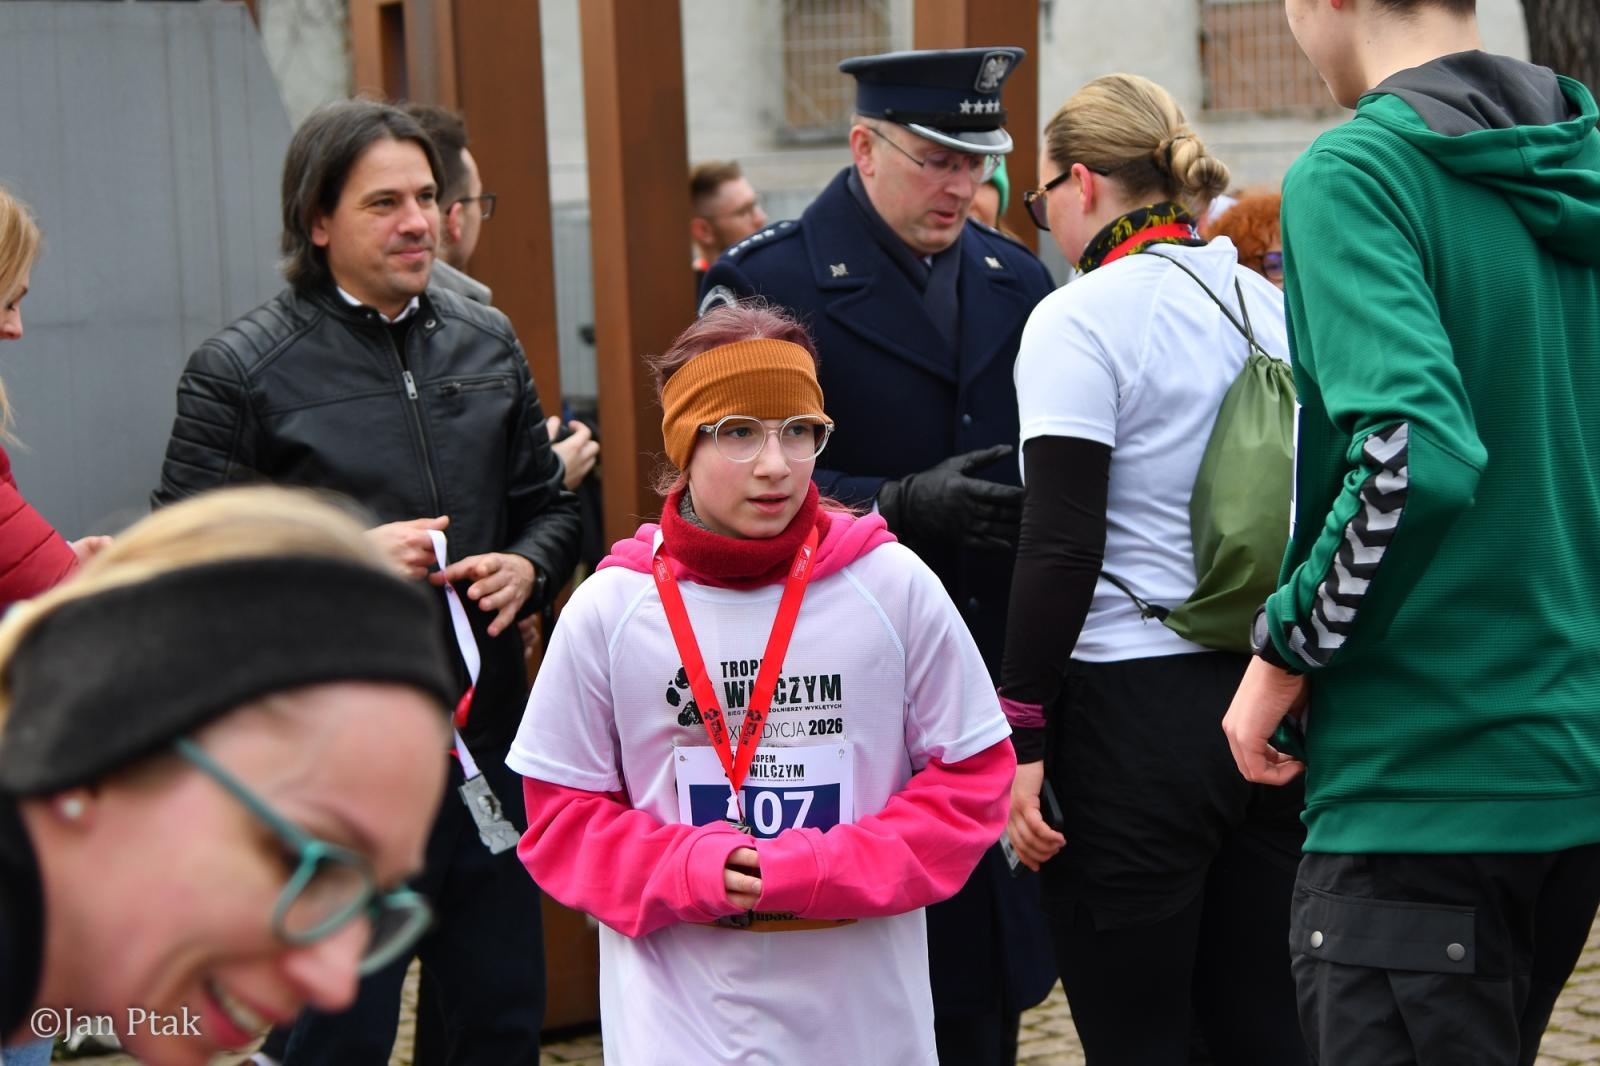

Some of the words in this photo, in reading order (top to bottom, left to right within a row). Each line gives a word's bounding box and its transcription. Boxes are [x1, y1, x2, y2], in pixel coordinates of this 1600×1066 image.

[720, 658, 783, 679] TROP
[724, 674, 842, 708] WCZYM
[729, 723, 747, 741] XI
[760, 721, 806, 740] DYCJA
[808, 717, 843, 736] 2026
[752, 754, 776, 763] ROPEM
[749, 763, 805, 778] WILCZYM
